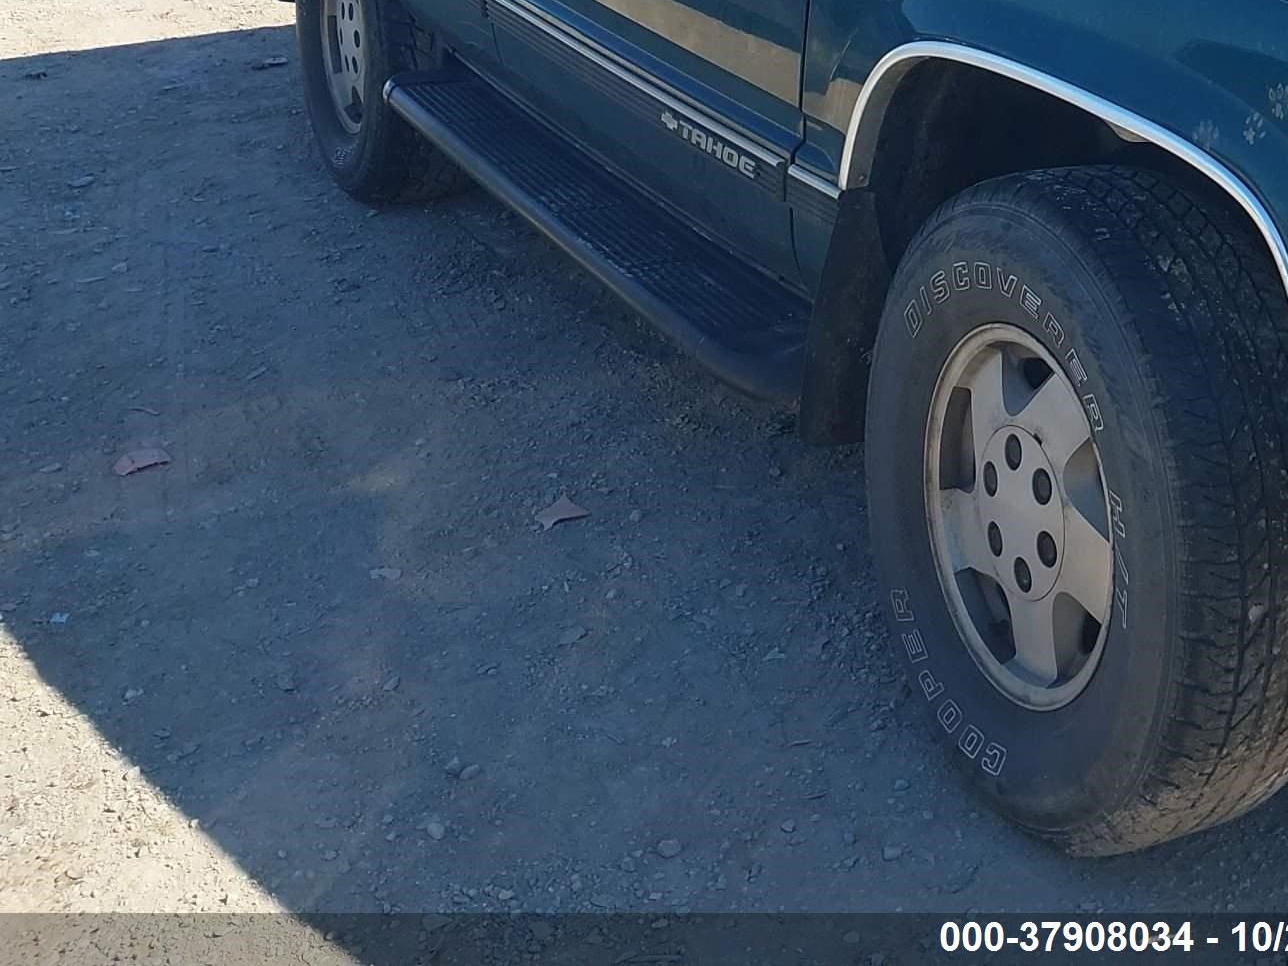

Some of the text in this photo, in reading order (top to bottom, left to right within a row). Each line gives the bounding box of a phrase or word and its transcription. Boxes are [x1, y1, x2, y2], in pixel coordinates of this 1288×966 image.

[680, 120, 756, 179] TAHOE
[903, 261, 1104, 432] DISCOVERER
[890, 589, 1007, 776] COOPER
